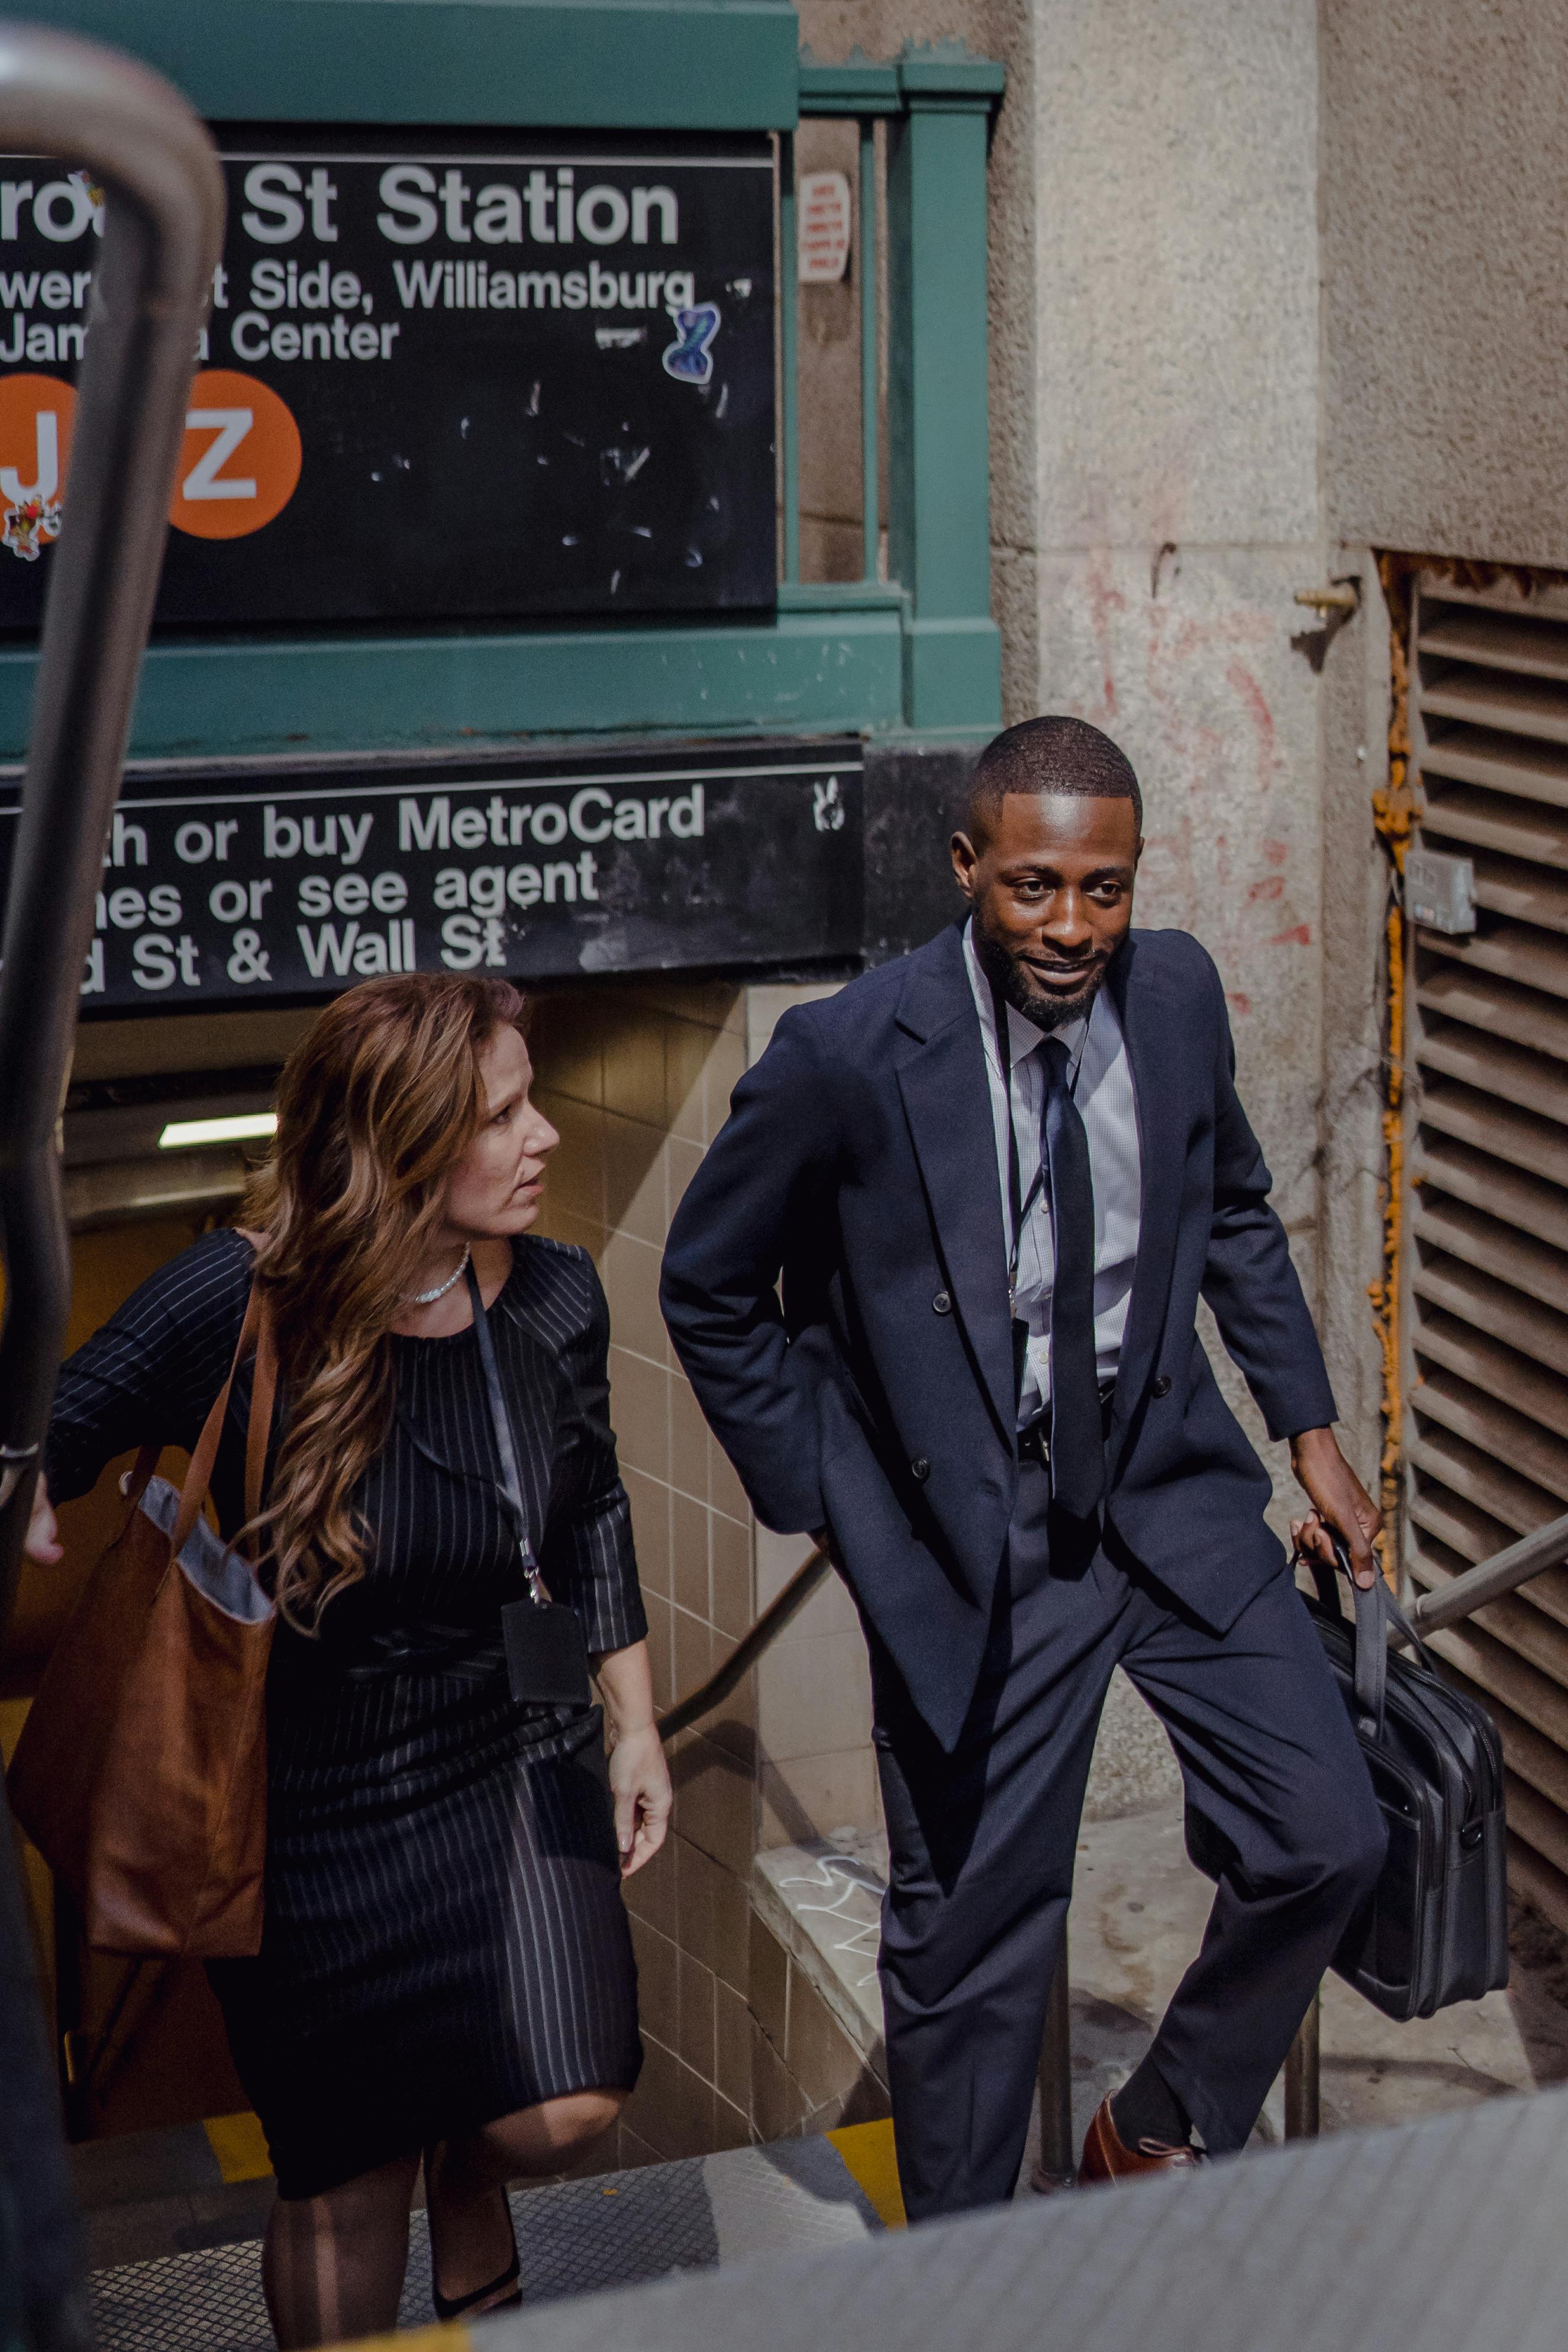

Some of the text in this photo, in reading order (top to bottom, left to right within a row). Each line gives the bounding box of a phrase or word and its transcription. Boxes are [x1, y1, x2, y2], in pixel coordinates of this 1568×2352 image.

[241, 163, 338, 244] St
[377, 164, 679, 244] Station
[249, 258, 373, 315] Side,
[392, 260, 695, 318] Williamsburg
[230, 311, 400, 361] Center
[0, 408, 257, 504] J Z
[174, 821, 238, 864] or
[263, 805, 374, 865] buy
[398, 784, 705, 851] MetroCard
[209, 879, 272, 923] or
[298, 872, 408, 918] see
[433, 851, 599, 918] agent
[131, 933, 201, 991] St
[227, 927, 273, 984] &
[297, 918, 416, 978] Wall
[440, 914, 507, 970] St
